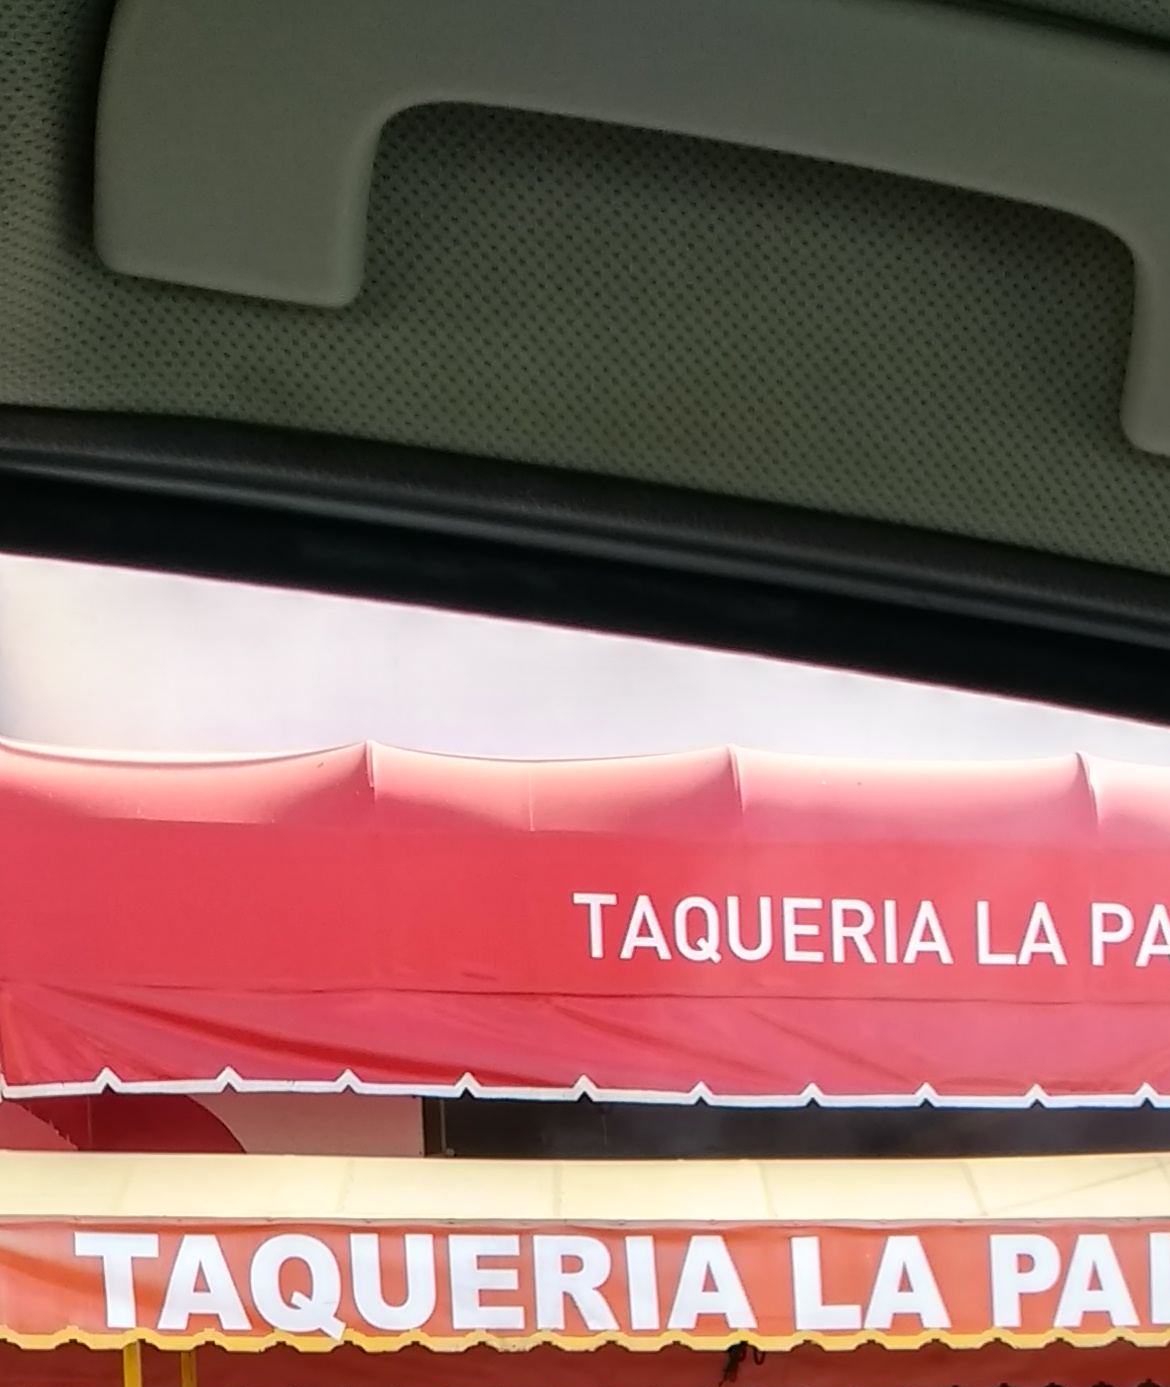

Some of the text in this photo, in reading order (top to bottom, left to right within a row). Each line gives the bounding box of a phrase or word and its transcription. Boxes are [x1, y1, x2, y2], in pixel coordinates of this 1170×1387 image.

[572, 892, 954, 964] TAQUERIA
[976, 900, 1069, 966] LA
[74, 1231, 758, 1341] TAQUERIA
[791, 1235, 951, 1332] LA
